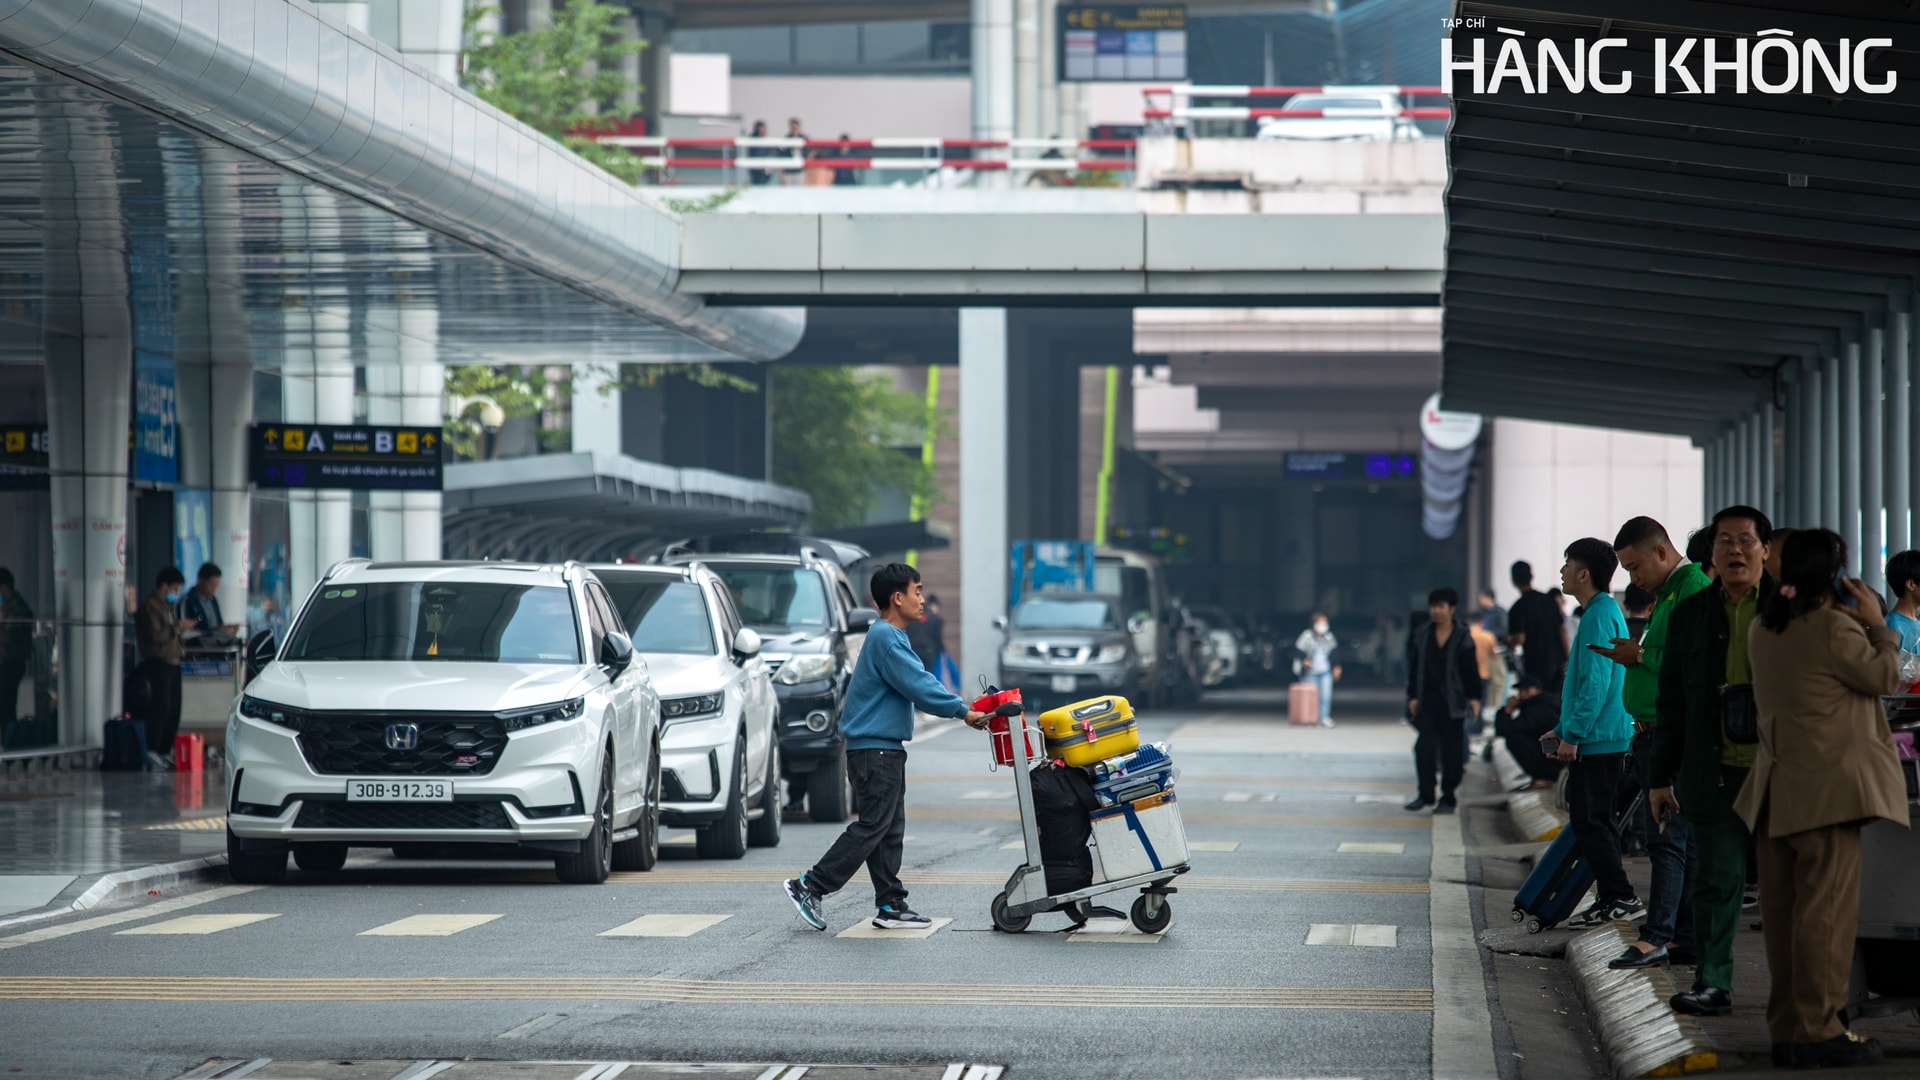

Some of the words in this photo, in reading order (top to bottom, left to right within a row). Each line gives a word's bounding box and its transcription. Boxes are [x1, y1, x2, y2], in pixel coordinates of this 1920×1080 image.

[306, 430, 325, 451] A
[375, 431, 394, 453] B
[356, 784, 444, 798] 30B-912.39
